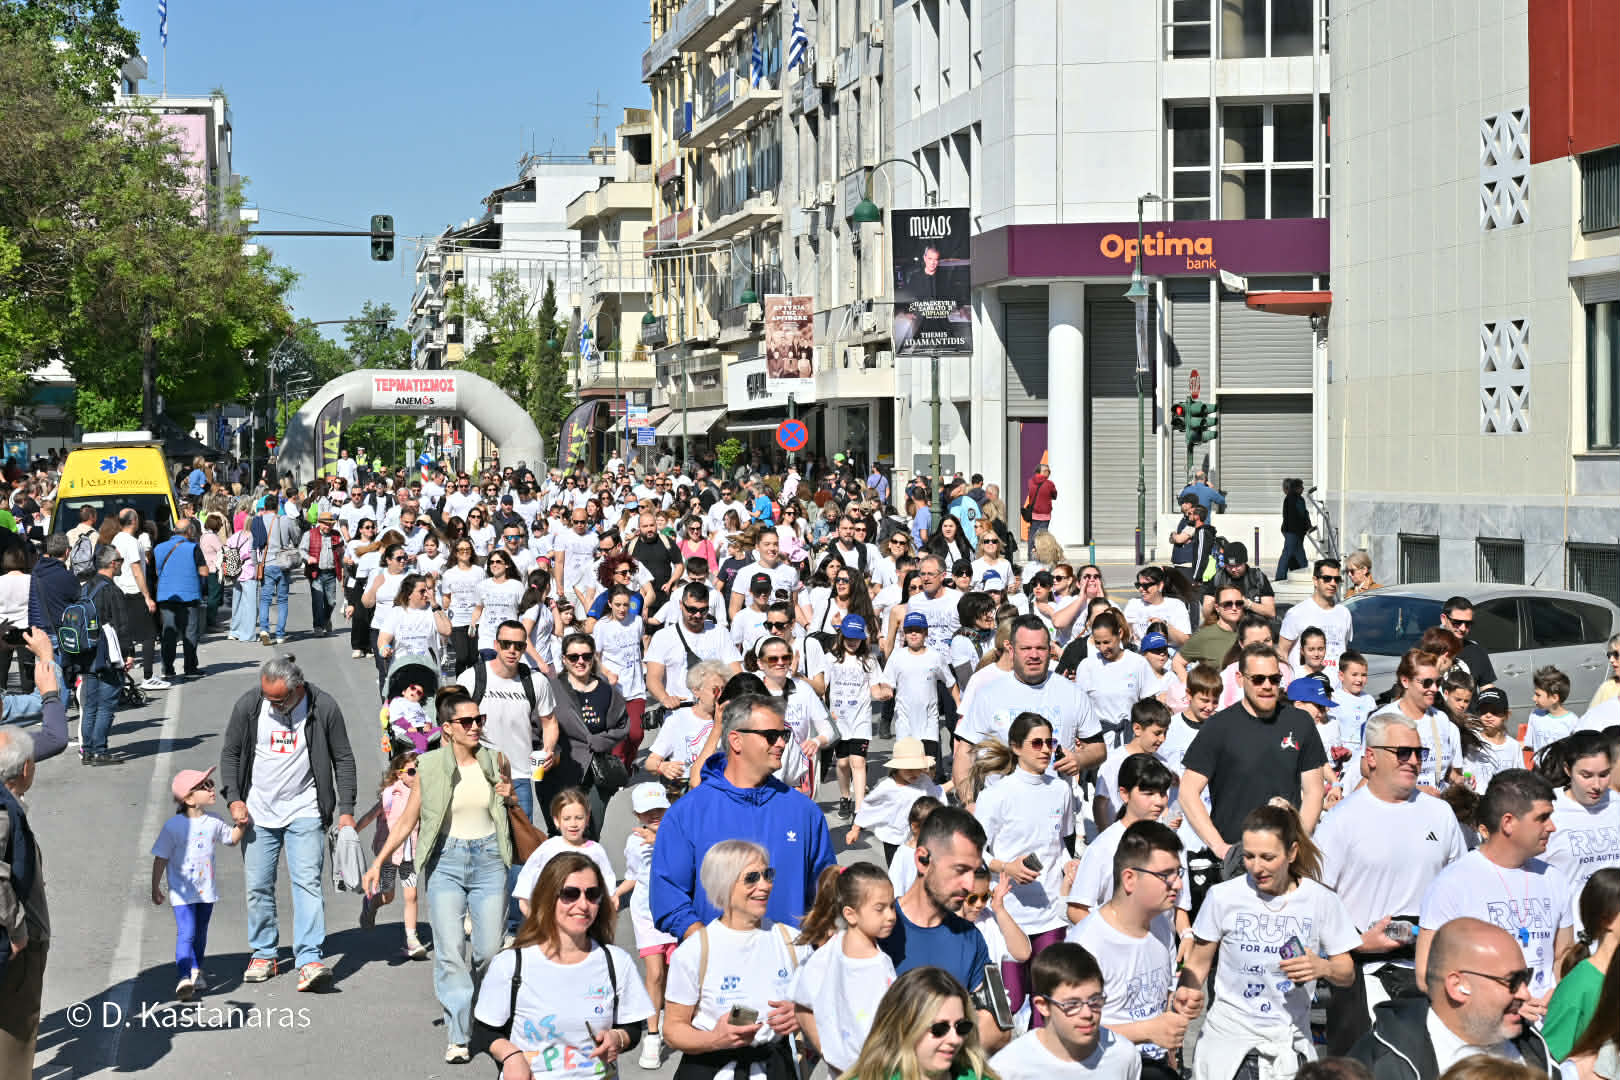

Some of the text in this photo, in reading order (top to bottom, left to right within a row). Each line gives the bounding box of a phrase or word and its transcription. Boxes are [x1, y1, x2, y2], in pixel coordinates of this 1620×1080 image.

[1100, 231, 1213, 263] Optima
[1187, 256, 1217, 270] bank
[904, 338, 965, 346] ADAMANTIDIS
[375, 378, 455, 392] ΤΕΡΜΑΤΙΣΜΟΣ
[1580, 856, 1595, 864] FOR
[1488, 898, 1553, 930] RUN
[1235, 913, 1313, 943] RUN
[1240, 944, 1260, 954] FOR
